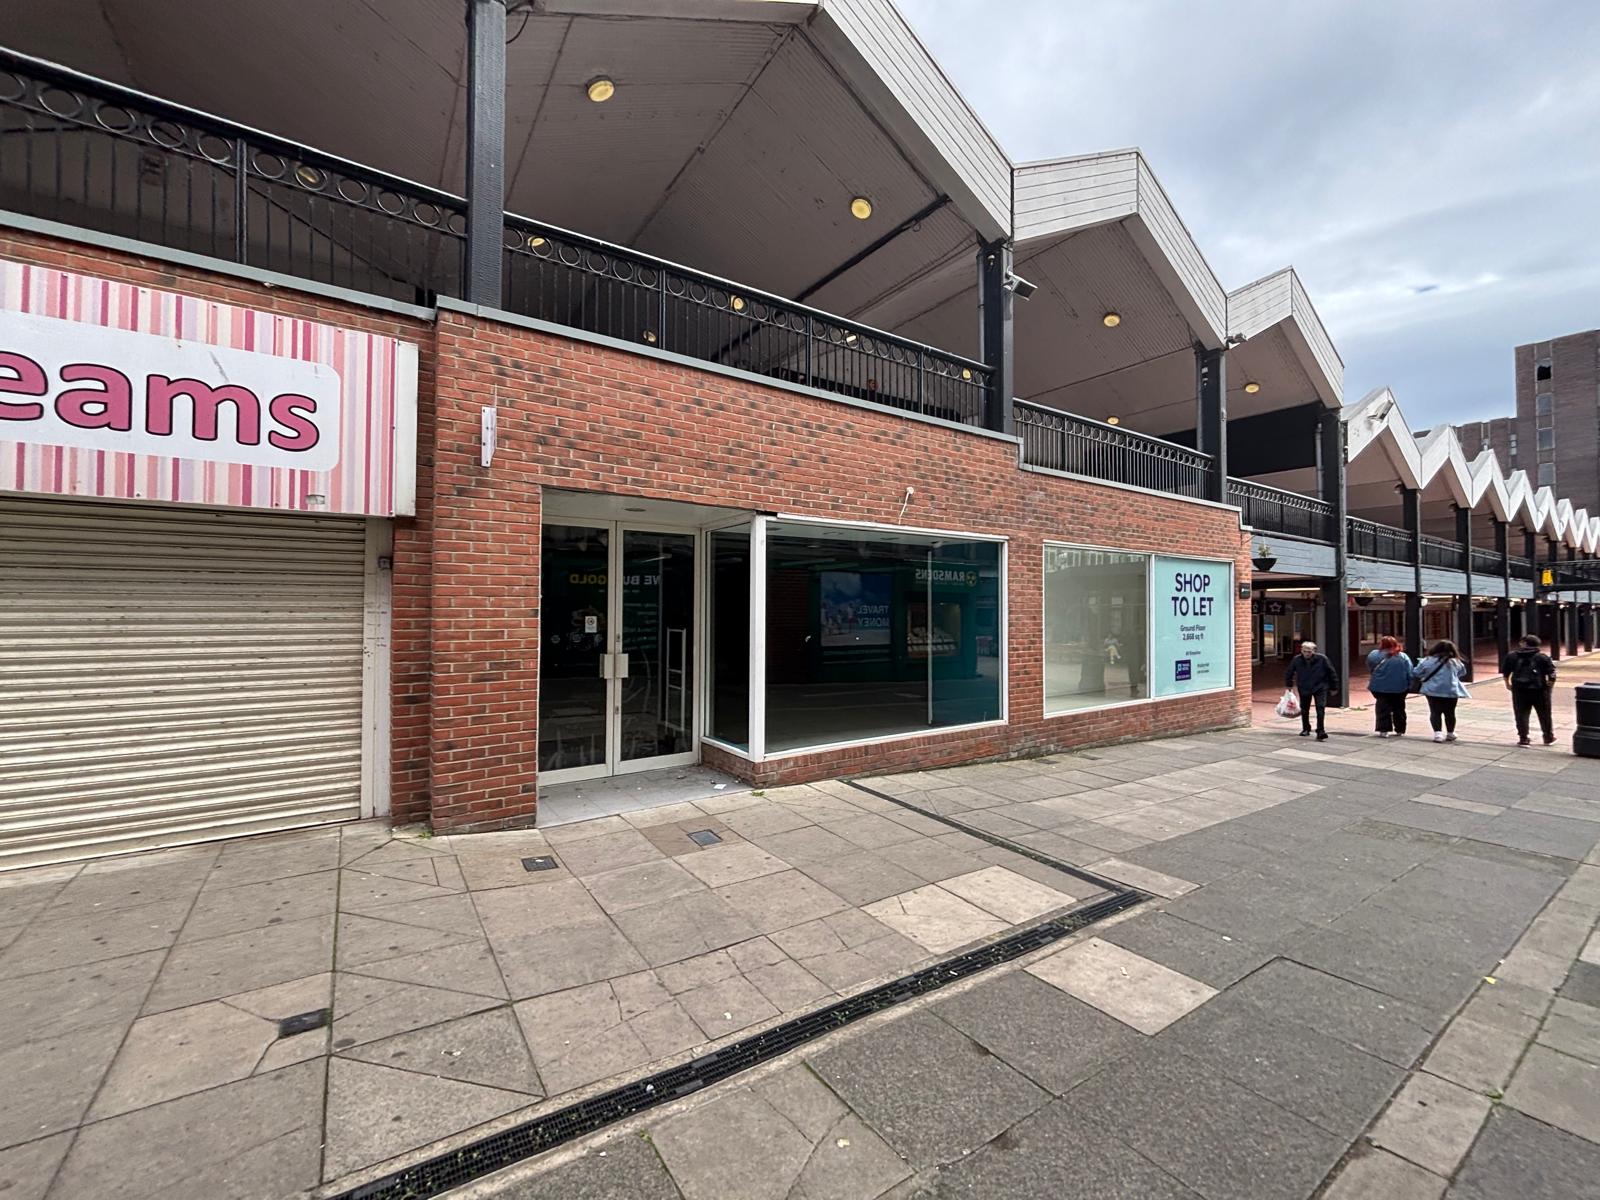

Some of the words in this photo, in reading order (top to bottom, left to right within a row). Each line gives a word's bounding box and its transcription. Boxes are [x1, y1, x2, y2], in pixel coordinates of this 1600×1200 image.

[0, 350, 319, 452] eams
[1175, 573, 1211, 593] SHOP
[1171, 596, 1189, 616] TO
[1192, 596, 1214, 616] LET
[1180, 624, 1195, 632] Ground
